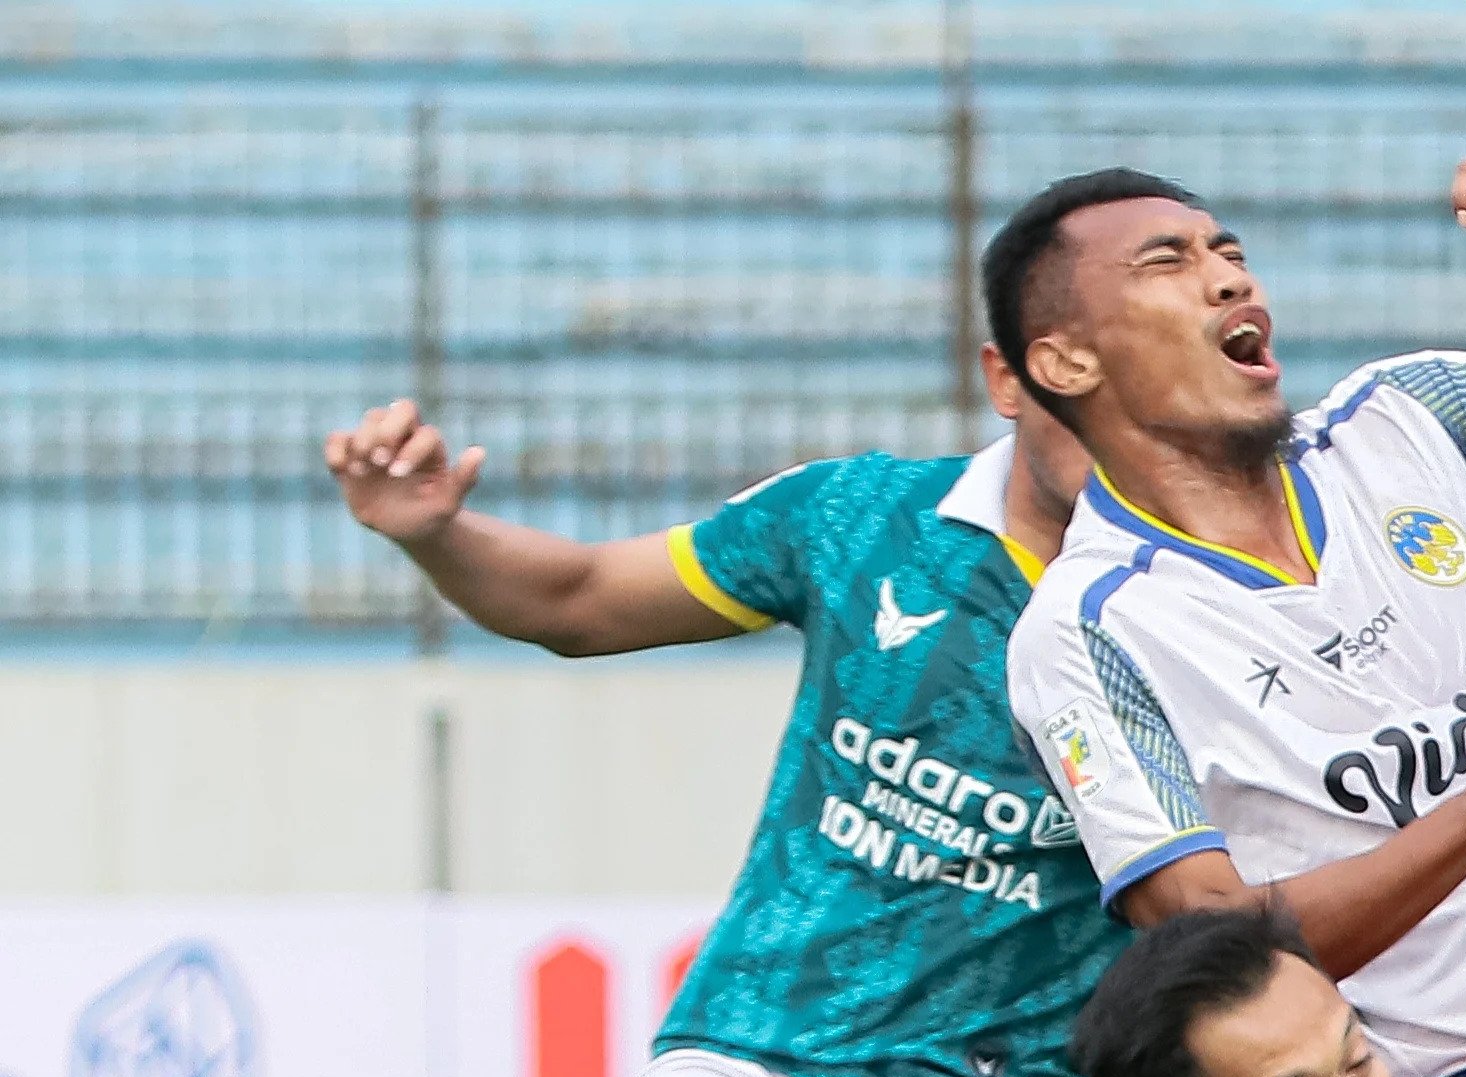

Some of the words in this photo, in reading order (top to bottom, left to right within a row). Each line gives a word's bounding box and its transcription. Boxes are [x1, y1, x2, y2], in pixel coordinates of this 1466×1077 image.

[832, 717, 1030, 835] adaro
[819, 795, 897, 868] IDN
[862, 780, 1014, 857] MINERAL
